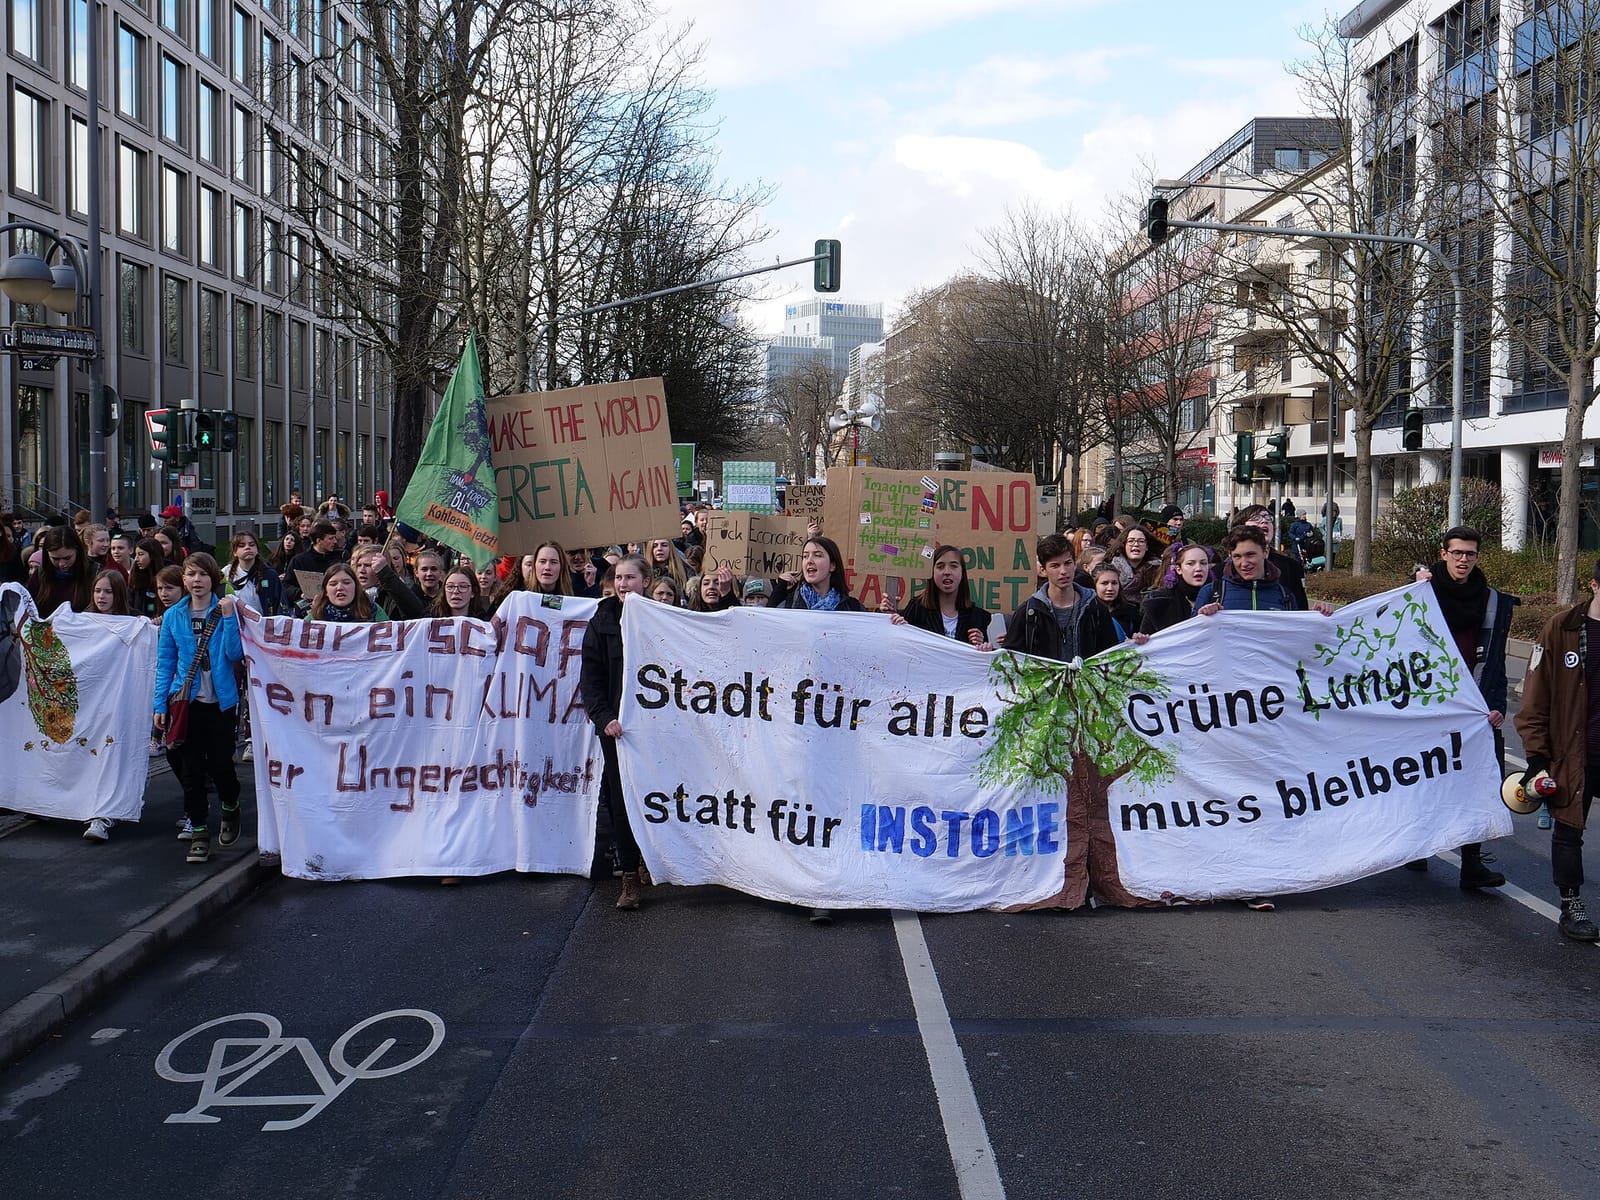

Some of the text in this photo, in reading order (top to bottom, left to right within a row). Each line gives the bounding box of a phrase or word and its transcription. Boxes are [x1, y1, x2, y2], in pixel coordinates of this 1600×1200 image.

[488, 395, 661, 452] MAKE THE WORLD
[494, 457, 596, 523] GRETA
[609, 465, 672, 512] AGAIN
[863, 492, 883, 513] all
[891, 494, 918, 516] the
[865, 477, 921, 501] Imagine
[971, 481, 1031, 532] NO
[859, 525, 908, 552] fighting
[912, 533, 929, 550] for
[872, 506, 916, 534] people
[708, 545, 741, 572] Save
[744, 547, 762, 572] the
[868, 552, 887, 563] our
[892, 551, 925, 569] earth
[964, 546, 995, 570] ON
[1013, 539, 1031, 570] A
[369, 671, 453, 720] ein
[480, 671, 591, 724] KLIMA
[635, 663, 988, 738] Stadt für alle
[1128, 651, 1433, 737] Grüne Lunge
[337, 743, 594, 812] Ungerechtigkeit
[1121, 732, 1463, 831] muss bleiben!
[644, 783, 1059, 858] statt für INSTONE
